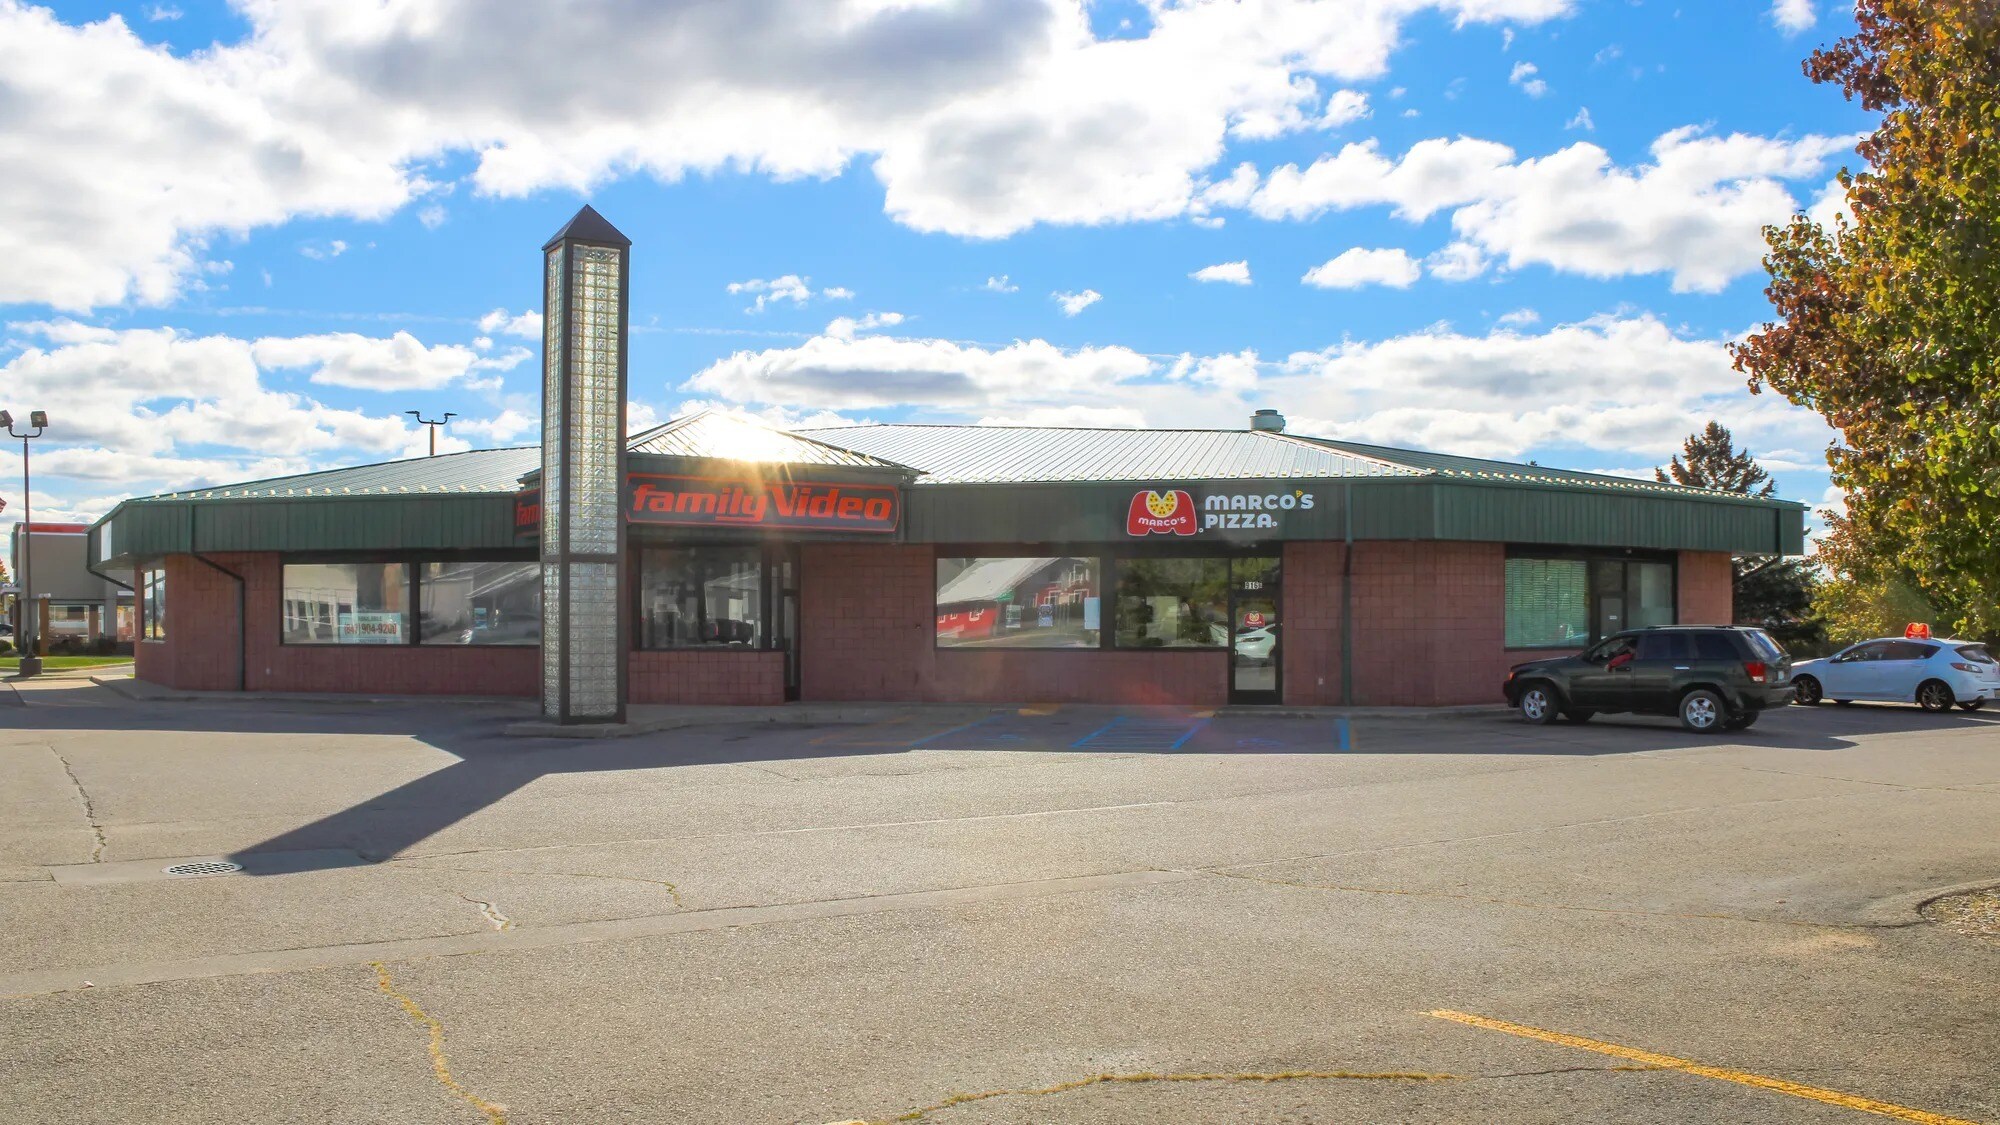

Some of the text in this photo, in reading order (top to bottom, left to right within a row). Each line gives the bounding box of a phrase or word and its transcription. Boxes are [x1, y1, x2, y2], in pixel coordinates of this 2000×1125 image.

[1205, 490, 1314, 511] MARCO'S
[516, 501, 541, 527] fam
[1138, 516, 1187, 527] MARCO'S
